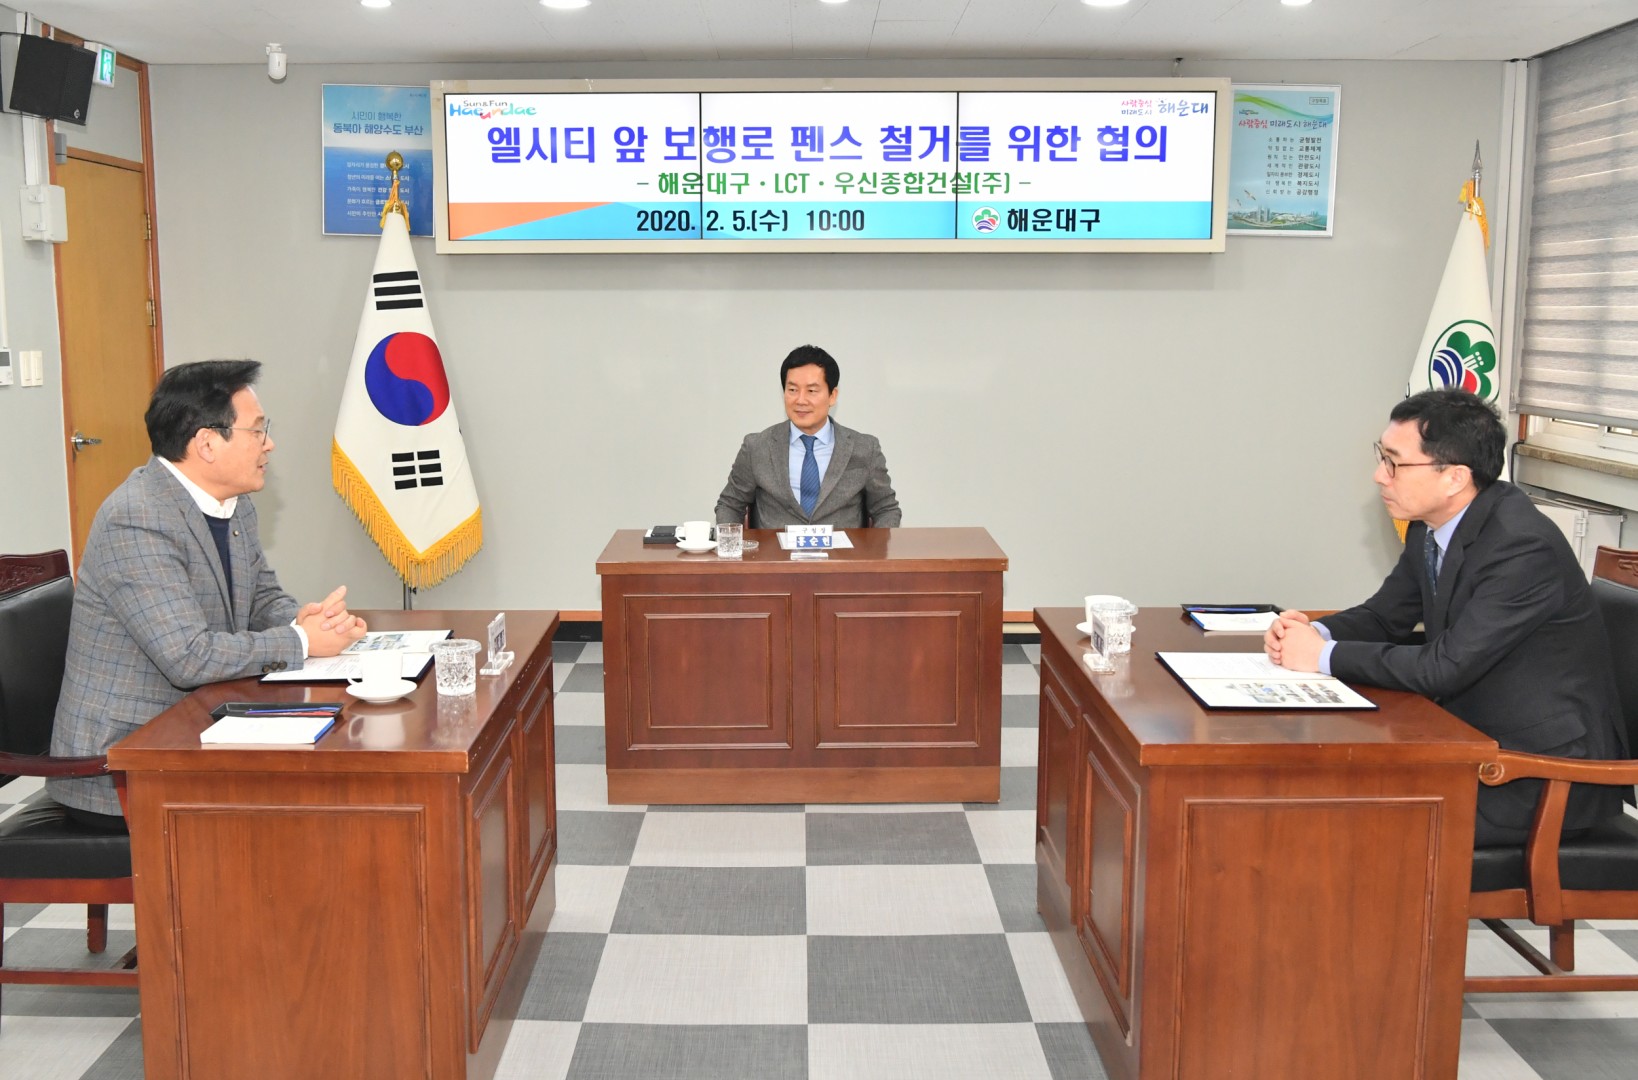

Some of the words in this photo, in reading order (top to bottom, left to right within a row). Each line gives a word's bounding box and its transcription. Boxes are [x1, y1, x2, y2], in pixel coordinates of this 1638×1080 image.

[449, 103, 537, 120] Haeundae
[1121, 99, 1152, 108] 사람중심
[1156, 99, 1209, 117] 해운대
[352, 112, 376, 120] 시민이
[378, 112, 402, 122] 행복한
[1238, 118, 1268, 128] 사람중심
[1270, 120, 1301, 128] 미래도시
[1302, 120, 1327, 130] 해운대
[333, 122, 361, 134] 동북아
[364, 124, 402, 135] 해양수도
[404, 125, 424, 136] 부산
[488, 126, 595, 164] 엘시티
[613, 126, 648, 164] 앞
[664, 126, 774, 164] 보행로
[791, 126, 862, 162] 펜스
[880, 126, 991, 162] 철거를
[1008, 125, 1081, 162] 위한
[1097, 125, 1168, 163] 협의
[658, 172, 750, 194] 해운대구
[774, 173, 810, 194] LCT
[834, 172, 1010, 194] 우신종합건설(주)
[636, 210, 695, 232] 2020.
[706, 210, 724, 232] 2.
[806, 210, 865, 231] 10:00
[1007, 208, 1101, 232] 해운대구
